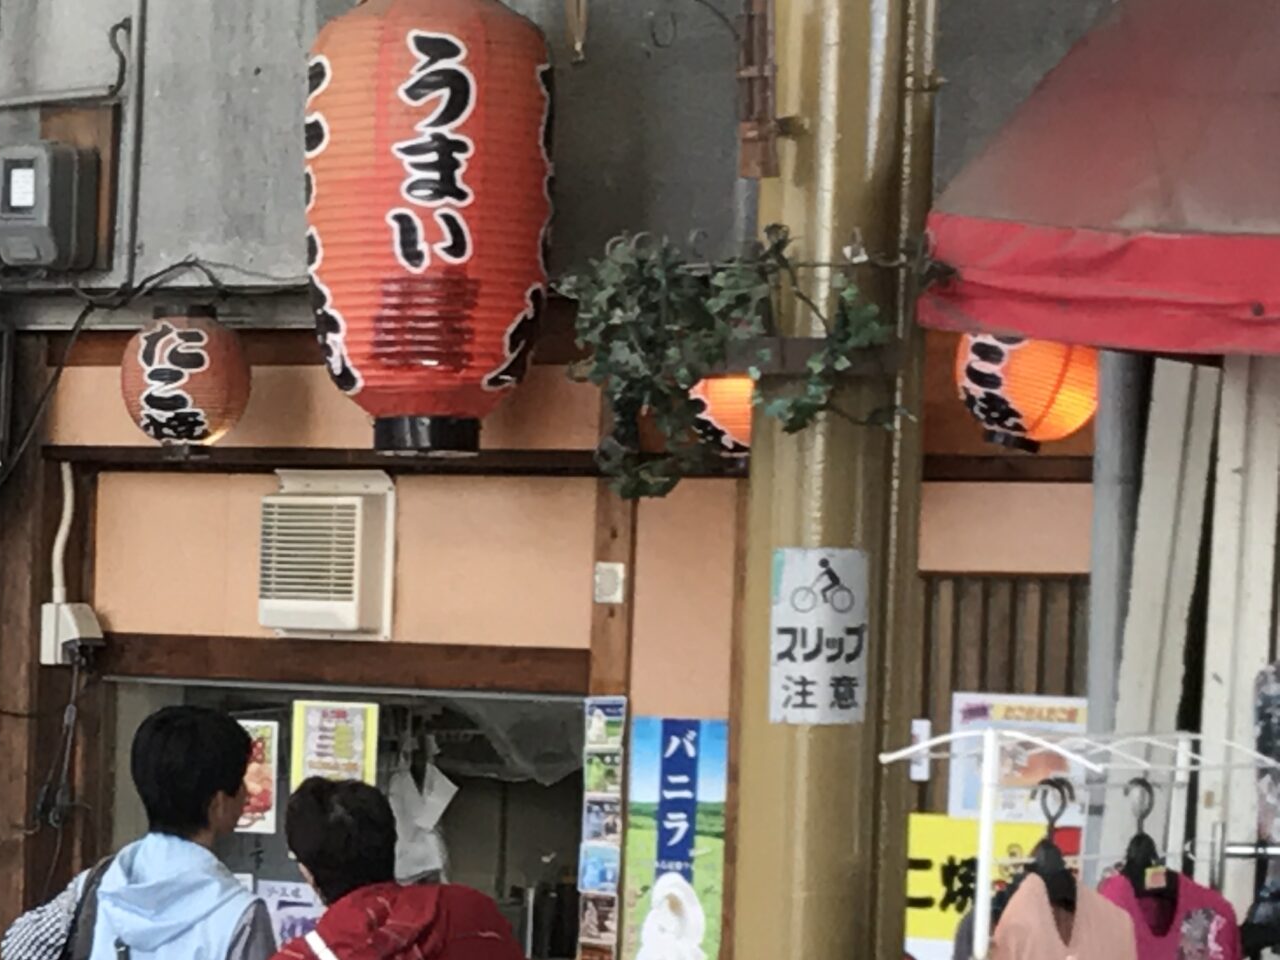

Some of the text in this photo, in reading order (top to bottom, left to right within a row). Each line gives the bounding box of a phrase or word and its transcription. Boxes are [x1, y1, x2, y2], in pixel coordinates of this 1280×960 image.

[386, 30, 475, 272] うまい
[963, 333, 1027, 434] こ焼
[776, 624, 866, 664] スリップ
[782, 675, 859, 709] 注意
[662, 729, 697, 846] バニラ
